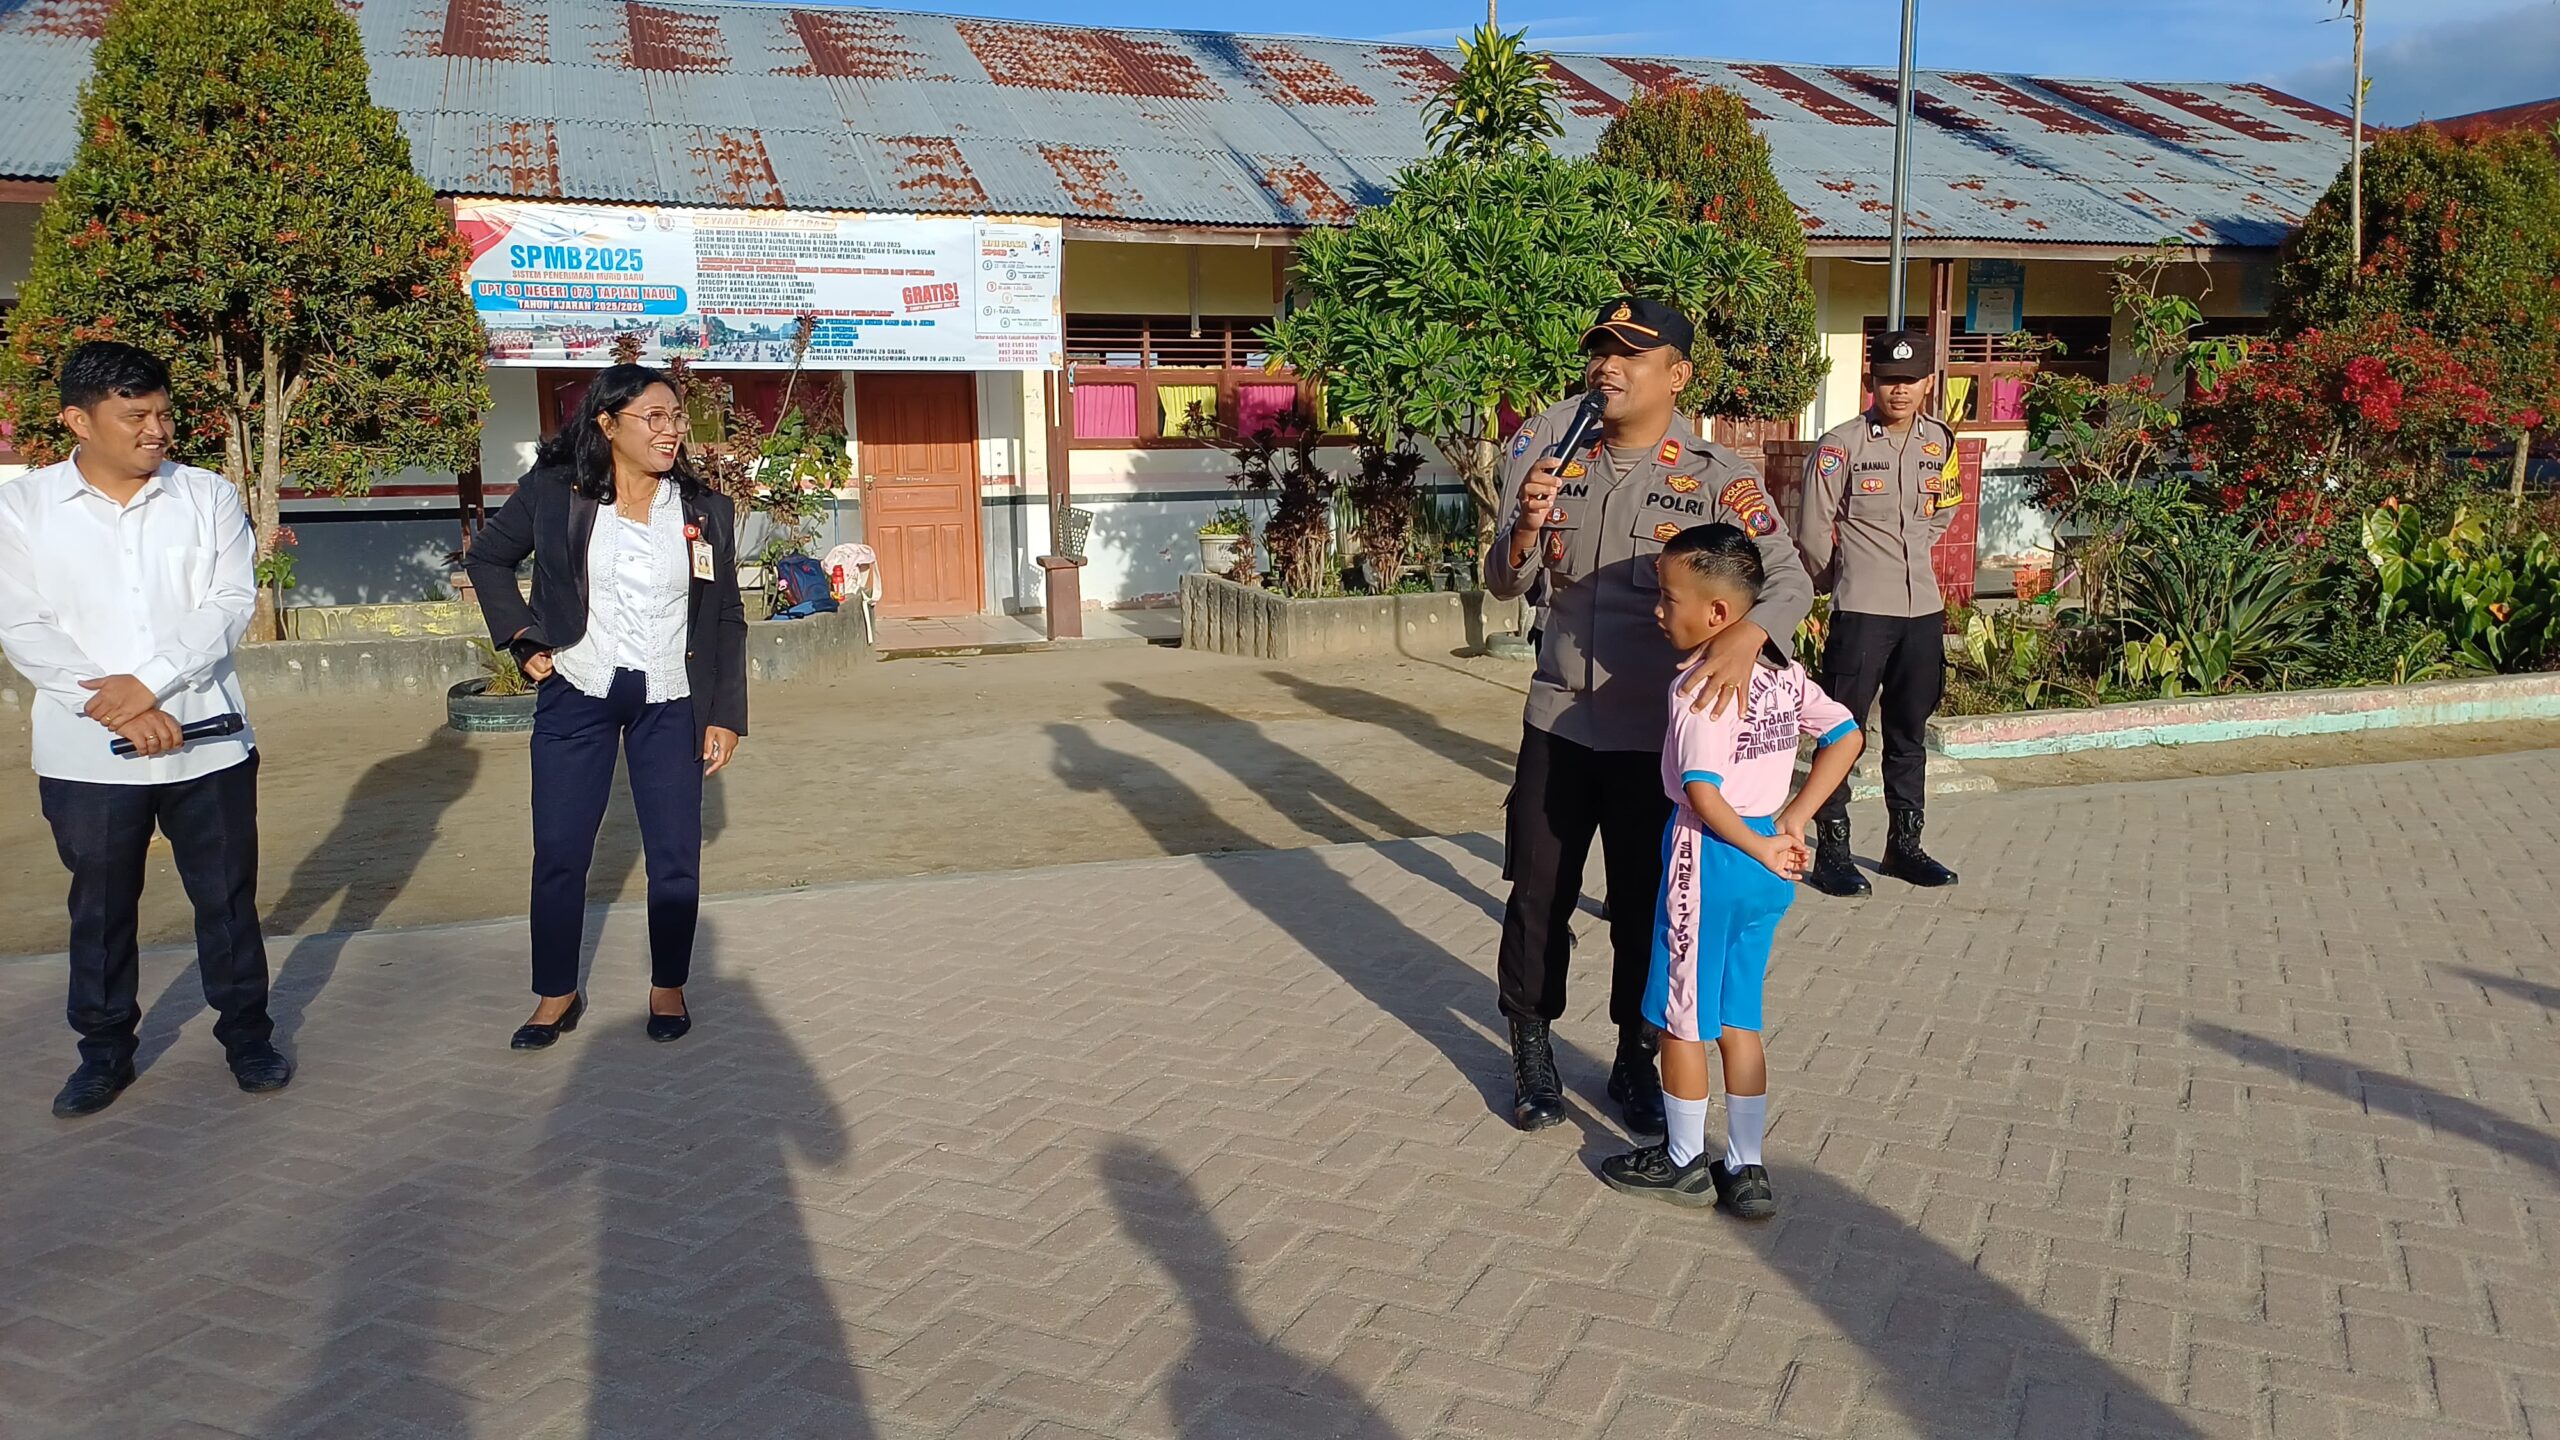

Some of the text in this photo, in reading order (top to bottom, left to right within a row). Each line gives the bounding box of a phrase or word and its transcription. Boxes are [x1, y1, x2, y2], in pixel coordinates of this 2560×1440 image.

[512, 270, 644, 281] SISTEM PENERIMAAN MURID BARU
[479, 284, 501, 295] UPT
[506, 284, 520, 296] SD
[525, 285, 567, 298] NEGERI
[597, 287, 638, 300] TAPIAN
[642, 288, 676, 300] NAULI
[902, 283, 959, 305] GRATIS!
[518, 300, 550, 310] TAHUN
[552, 301, 591, 311] AJARAN
[1646, 493, 1704, 516] POLRI
